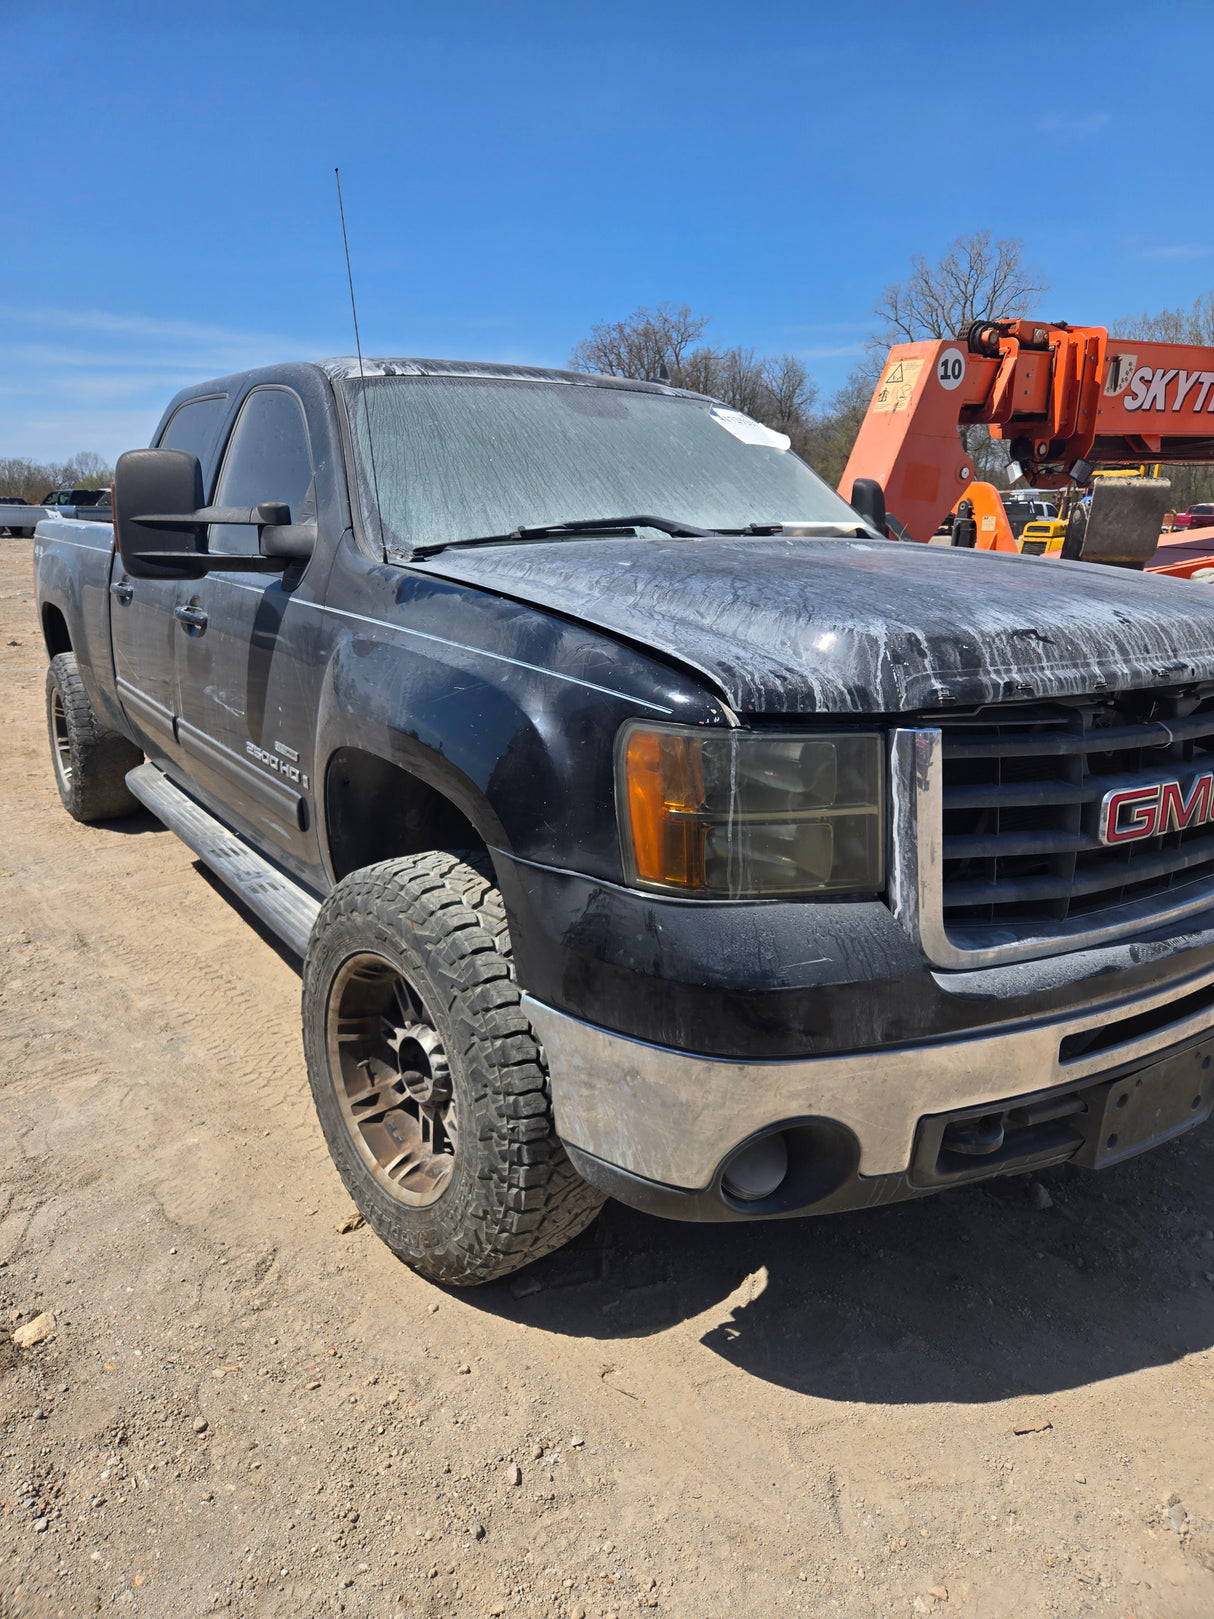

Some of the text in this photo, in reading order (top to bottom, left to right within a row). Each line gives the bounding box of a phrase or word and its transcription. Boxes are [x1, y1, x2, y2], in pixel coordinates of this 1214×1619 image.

[940, 358, 962, 380] 10
[1123, 366, 1214, 414] SKYT
[1099, 771, 1214, 846] GM
